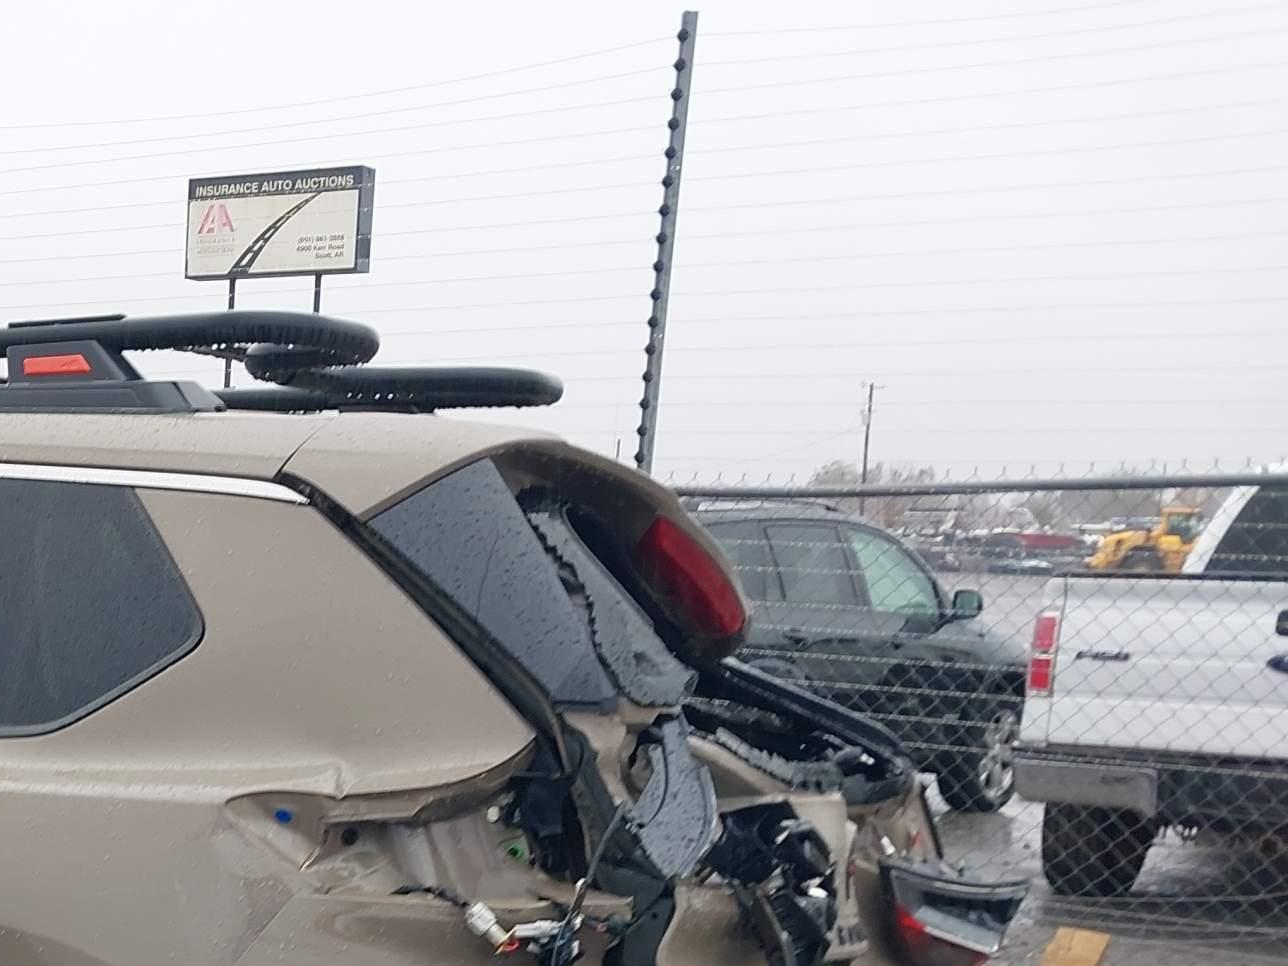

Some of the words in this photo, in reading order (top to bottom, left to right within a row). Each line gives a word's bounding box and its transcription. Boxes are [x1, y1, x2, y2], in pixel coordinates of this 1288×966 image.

[195, 182, 259, 197] INSURANCE
[262, 178, 292, 191] AUTO
[295, 175, 354, 189] AUCTIONS
